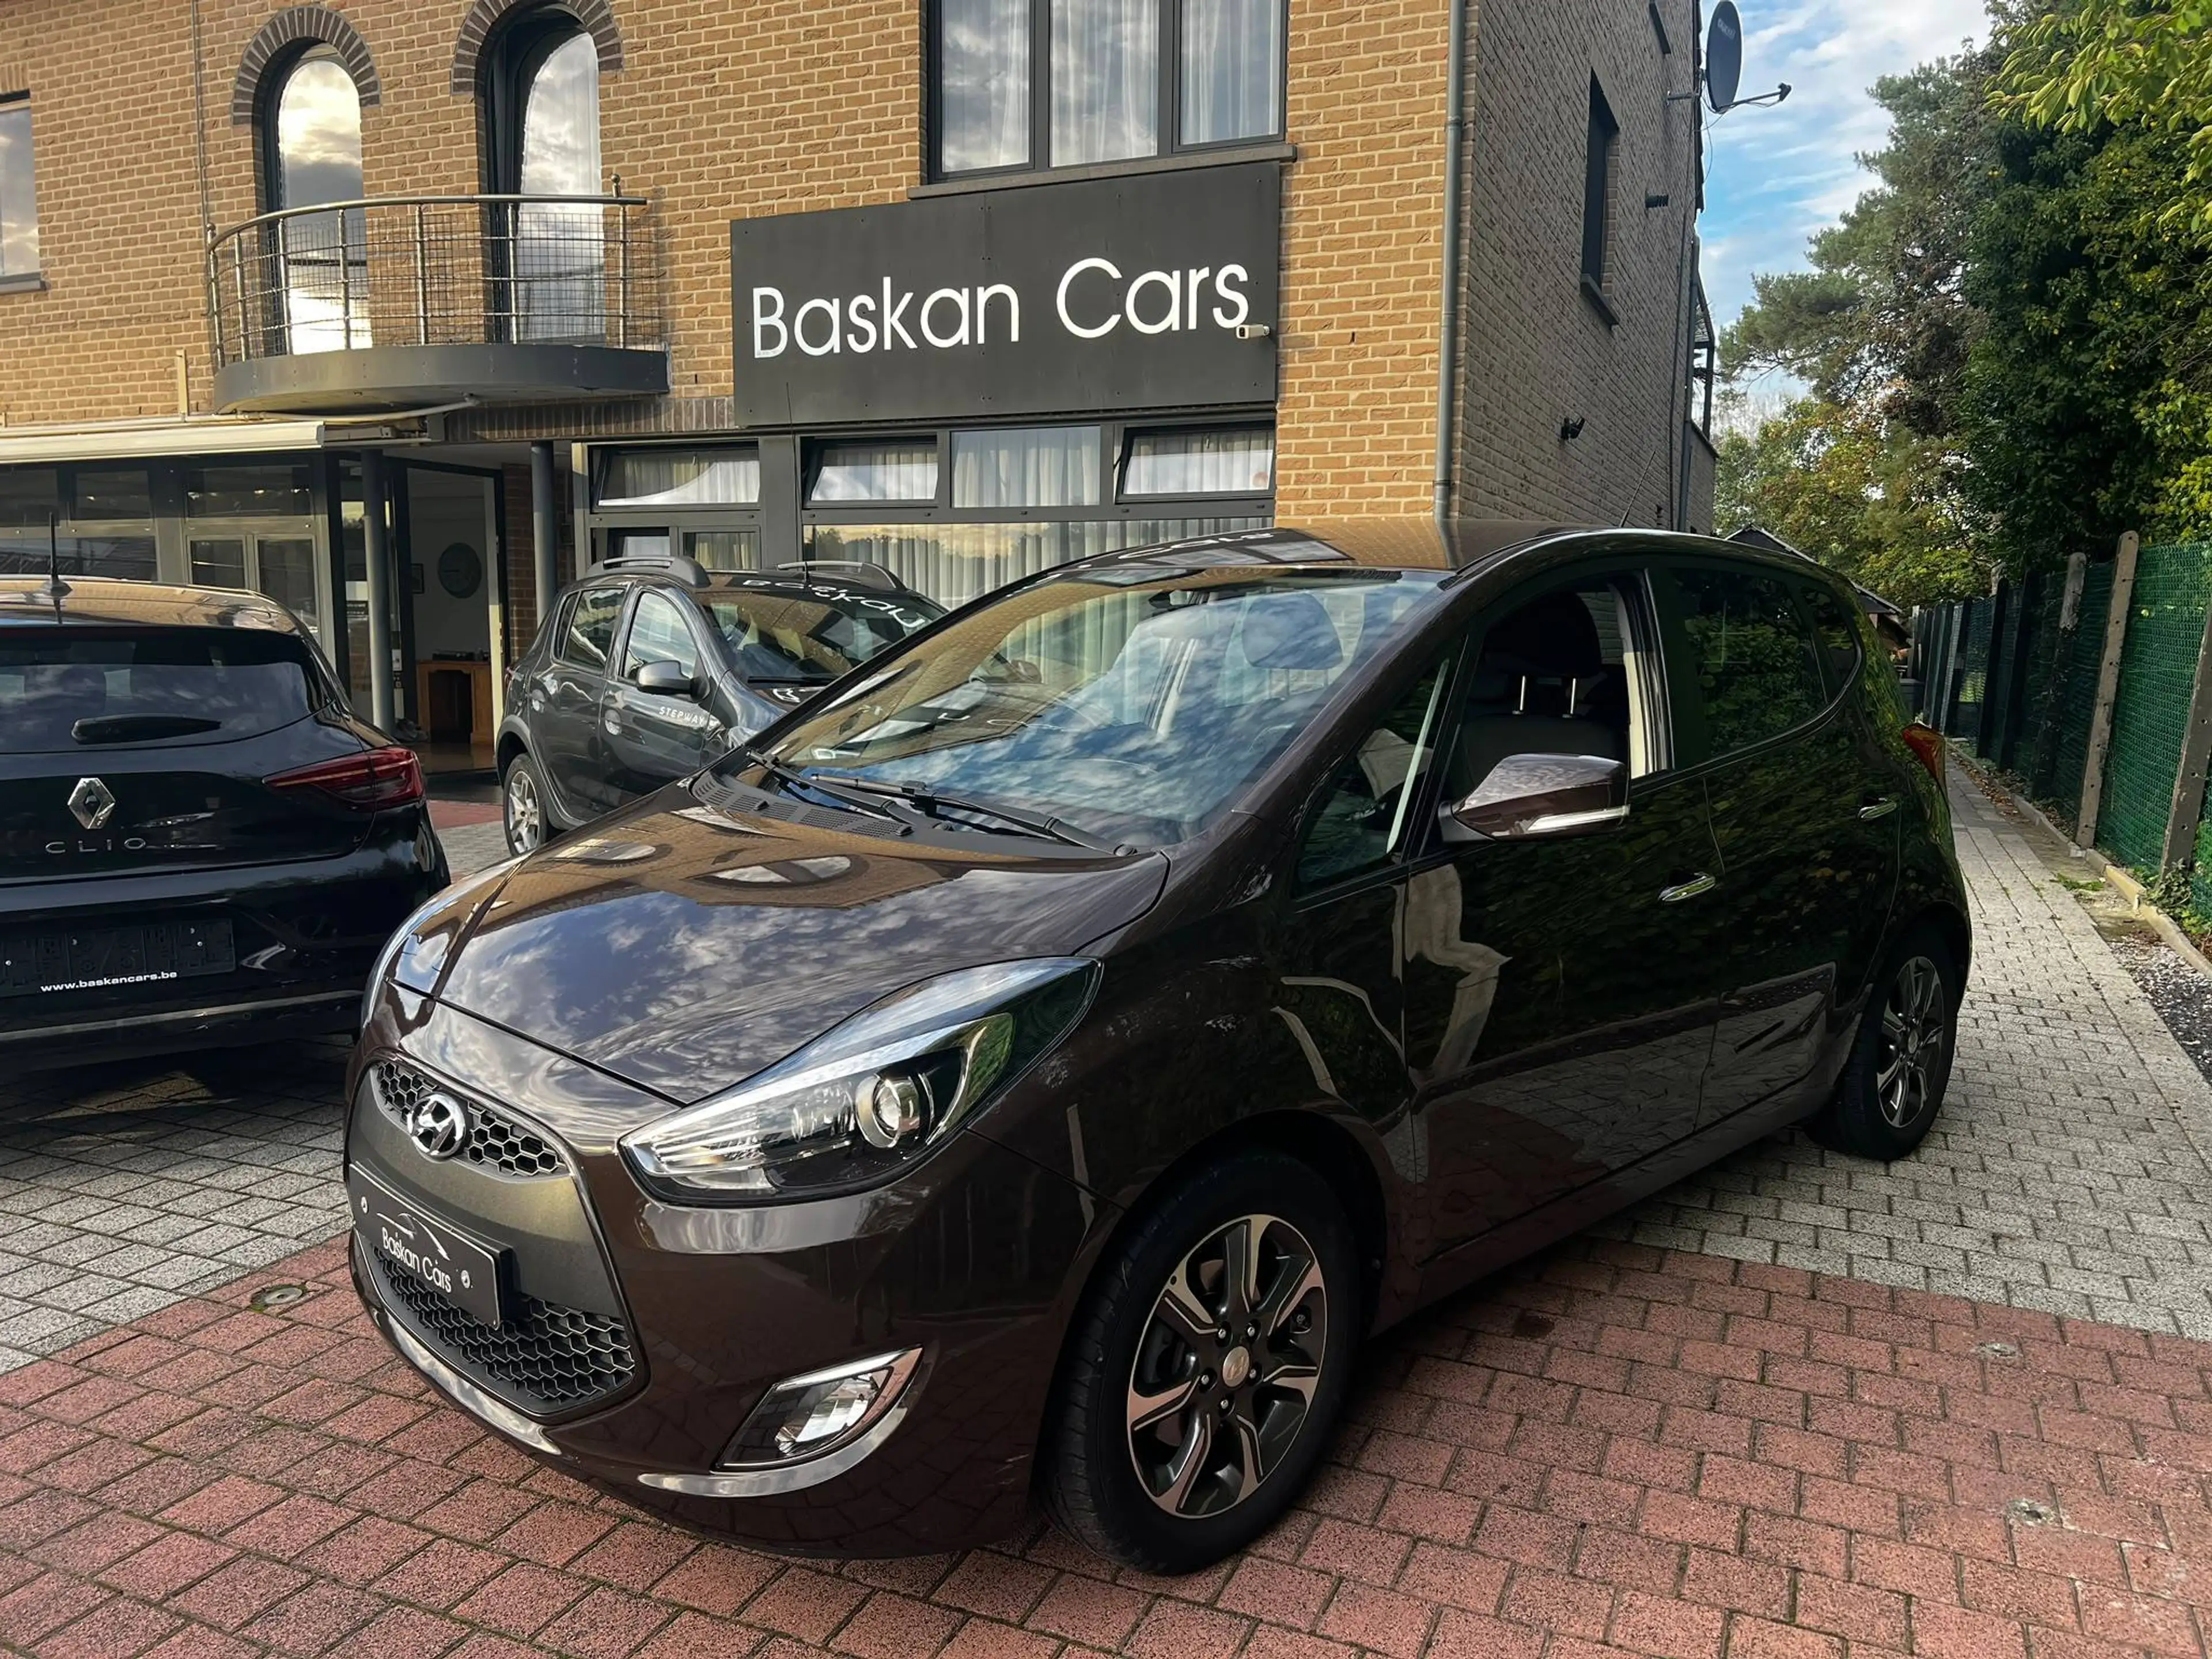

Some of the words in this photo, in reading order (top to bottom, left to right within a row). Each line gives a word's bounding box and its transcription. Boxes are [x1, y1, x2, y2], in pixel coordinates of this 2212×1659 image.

[753, 276, 1019, 358] Baskan
[1056, 257, 1249, 339] Cars
[658, 706, 704, 725] STEPWAY
[46, 838, 146, 853] CLIO
[40, 971, 177, 993] www.baskancars.be
[382, 1227, 420, 1272] Baskan
[422, 1256, 451, 1293] Cars
